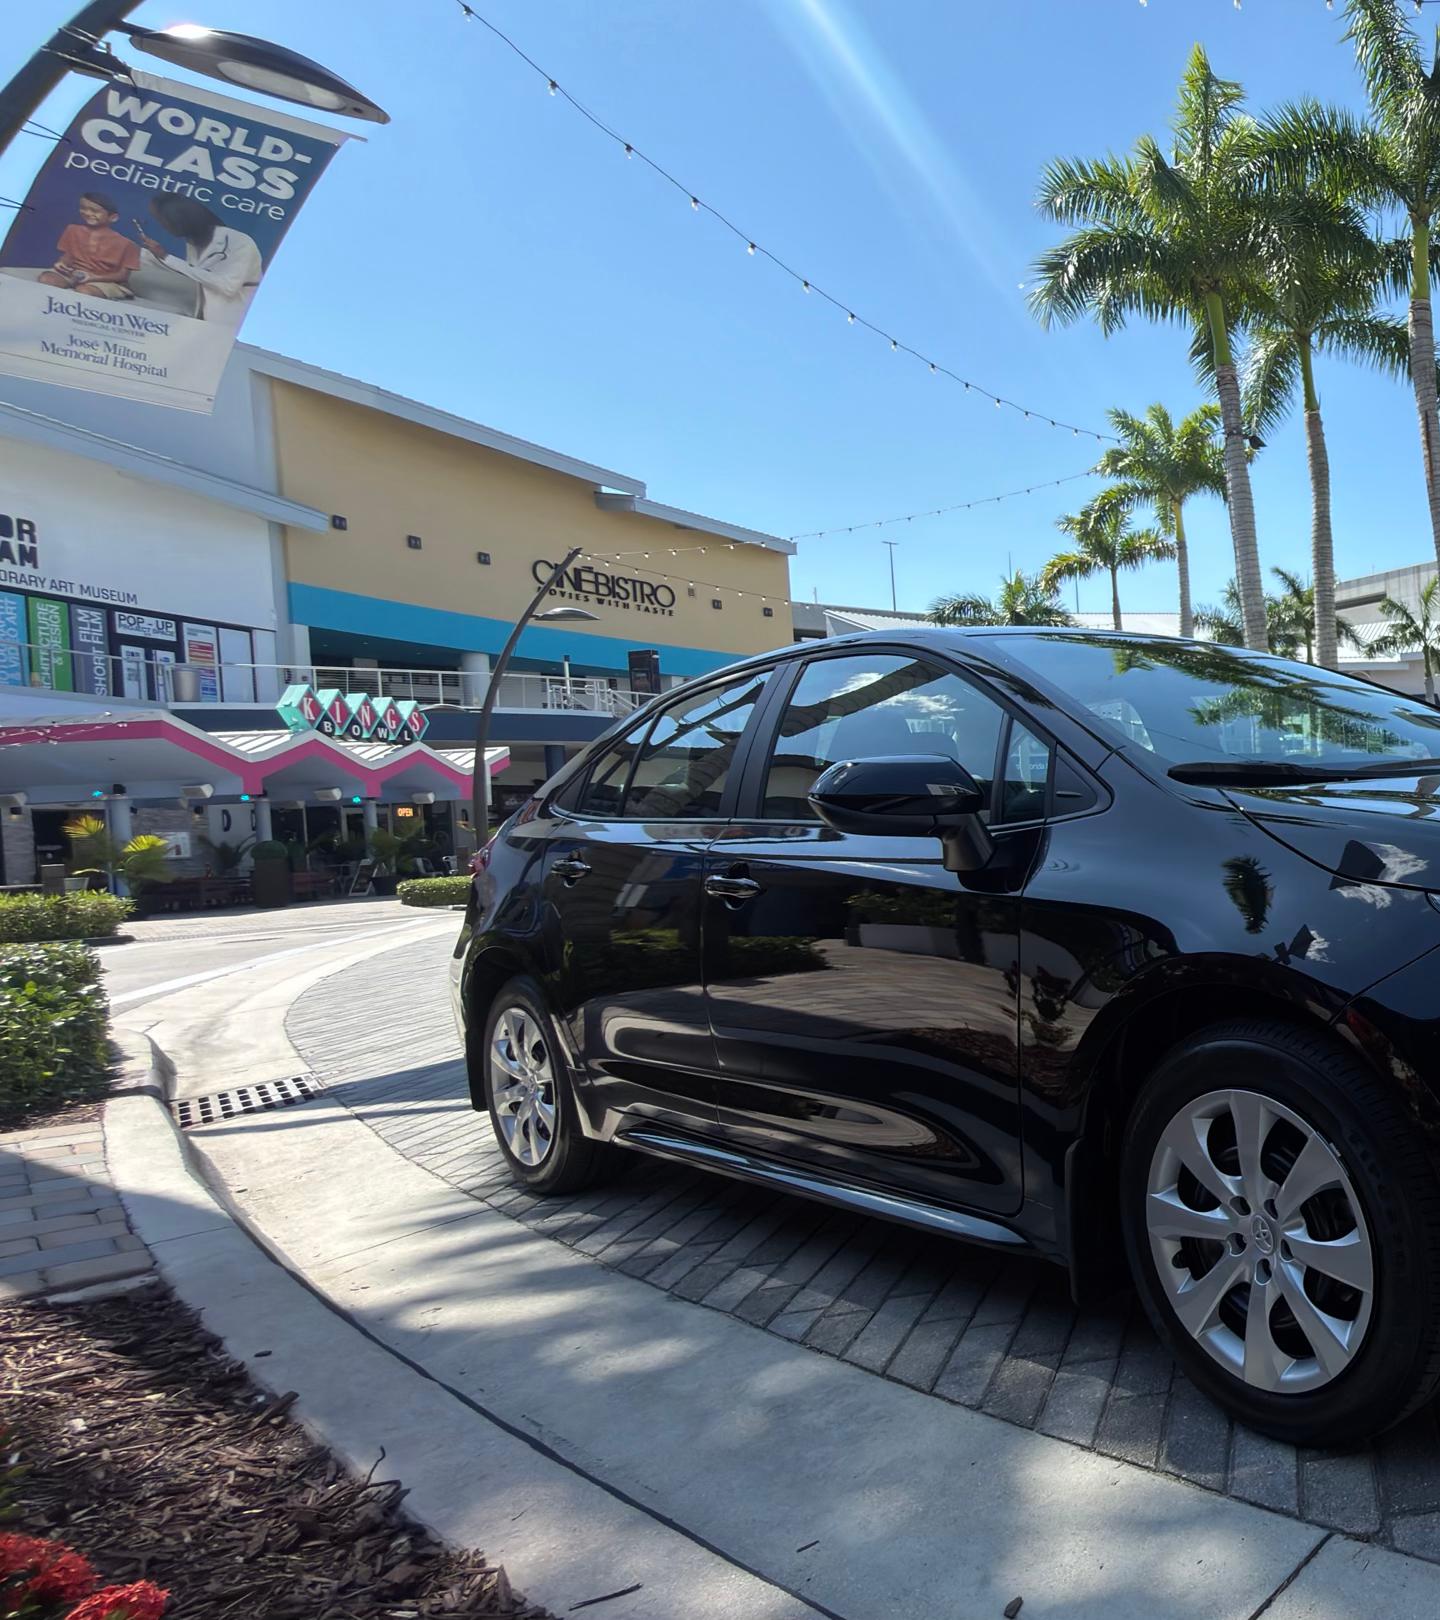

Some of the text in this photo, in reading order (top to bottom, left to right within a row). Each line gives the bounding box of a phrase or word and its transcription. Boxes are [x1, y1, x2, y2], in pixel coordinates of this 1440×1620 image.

[107, 90, 312, 164] WORLD-
[81, 118, 299, 200] CLASS
[64, 151, 285, 221] pediatric care
[42, 296, 170, 336] Jackson West
[41, 340, 168, 378] Memorial Hospital
[104, 341, 147, 361] Milton
[49, 579, 75, 594] ART
[79, 583, 138, 605] MUSEUM
[537, 586, 675, 617] OVIES WITH TASTE
[77, 608, 91, 642] FILM
[118, 613, 144, 627] POP
[156, 619, 173, 632] UP
[89, 610, 107, 696] SHORT FILM
[303, 697, 419, 732] KINGS
[323, 721, 411, 741] BOWL
[397, 807, 414, 817] OPEN
